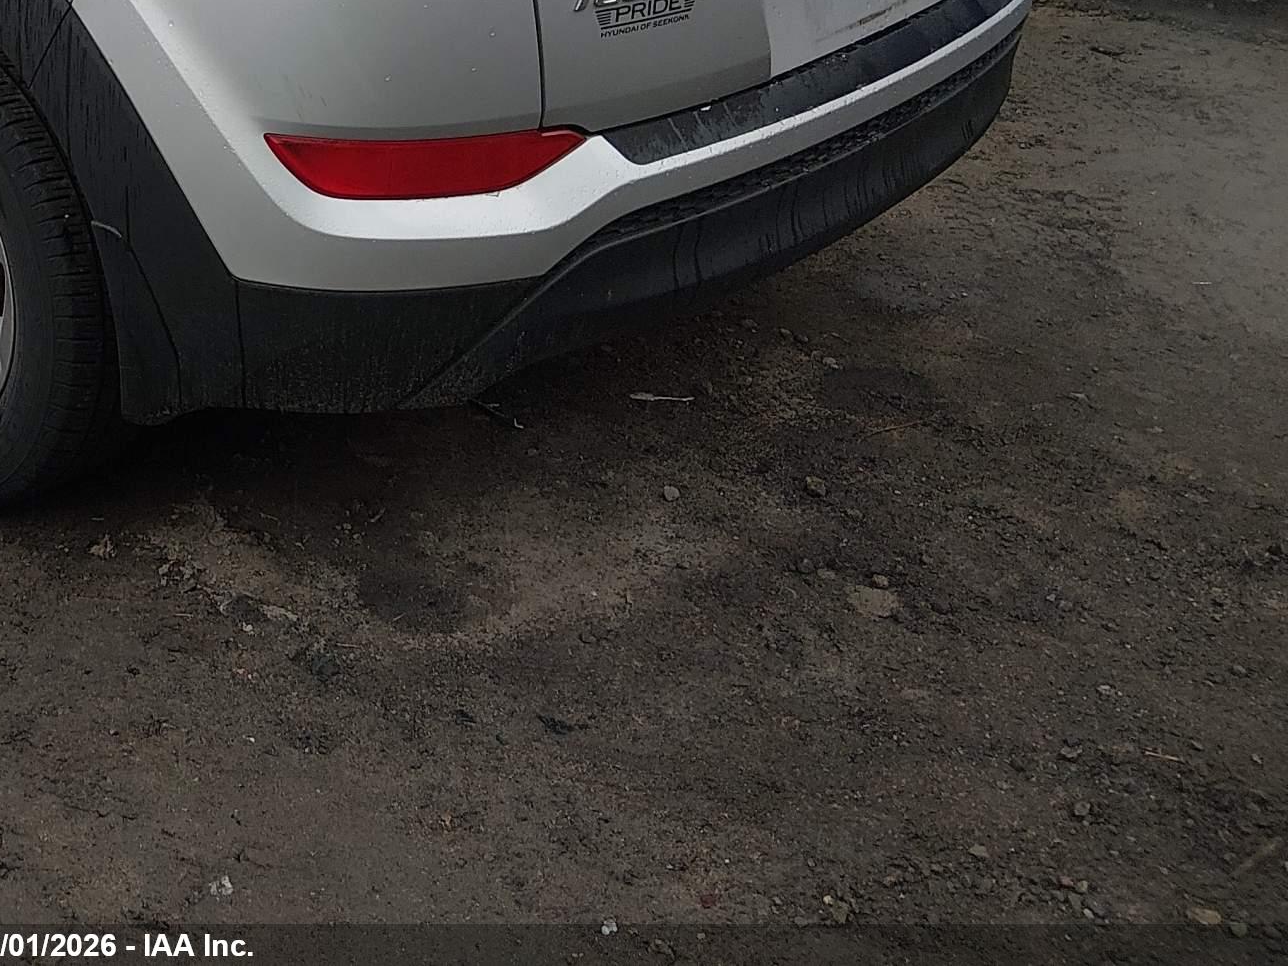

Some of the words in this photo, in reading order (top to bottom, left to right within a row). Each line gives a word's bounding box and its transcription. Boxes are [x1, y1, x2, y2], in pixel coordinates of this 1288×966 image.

[600, 25, 639, 38] HYUNDAI
[640, 22, 651, 31] OF
[652, 14, 690, 28] SEEKONK
